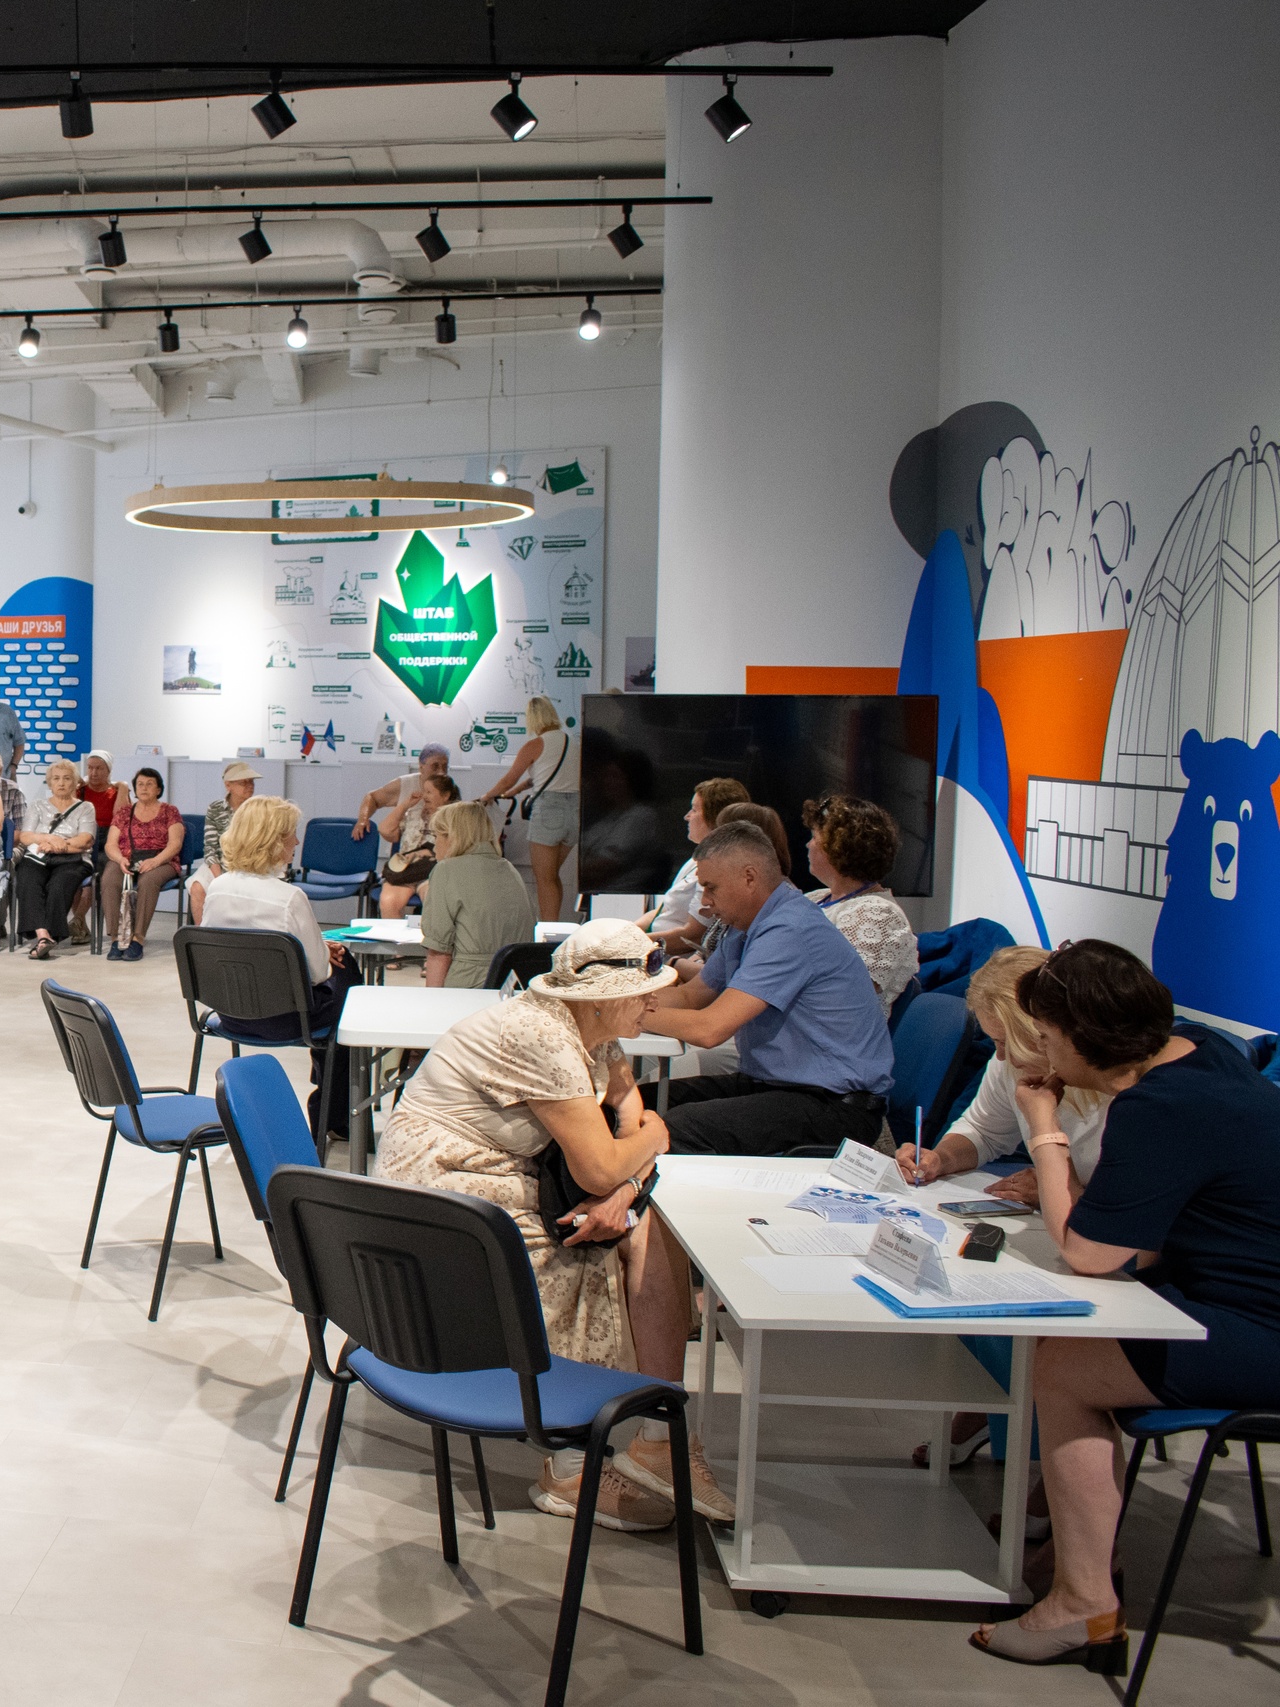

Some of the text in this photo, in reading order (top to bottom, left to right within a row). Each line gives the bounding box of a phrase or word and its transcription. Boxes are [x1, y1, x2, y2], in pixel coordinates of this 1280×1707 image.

[413, 606, 454, 619] ШТАБ
[22, 620, 62, 635] ДРУЗЬЯ
[389, 630, 478, 643] ОБЩЕСТВЕННОЙ
[399, 656, 467, 667] ПОДДЕРЖКИ
